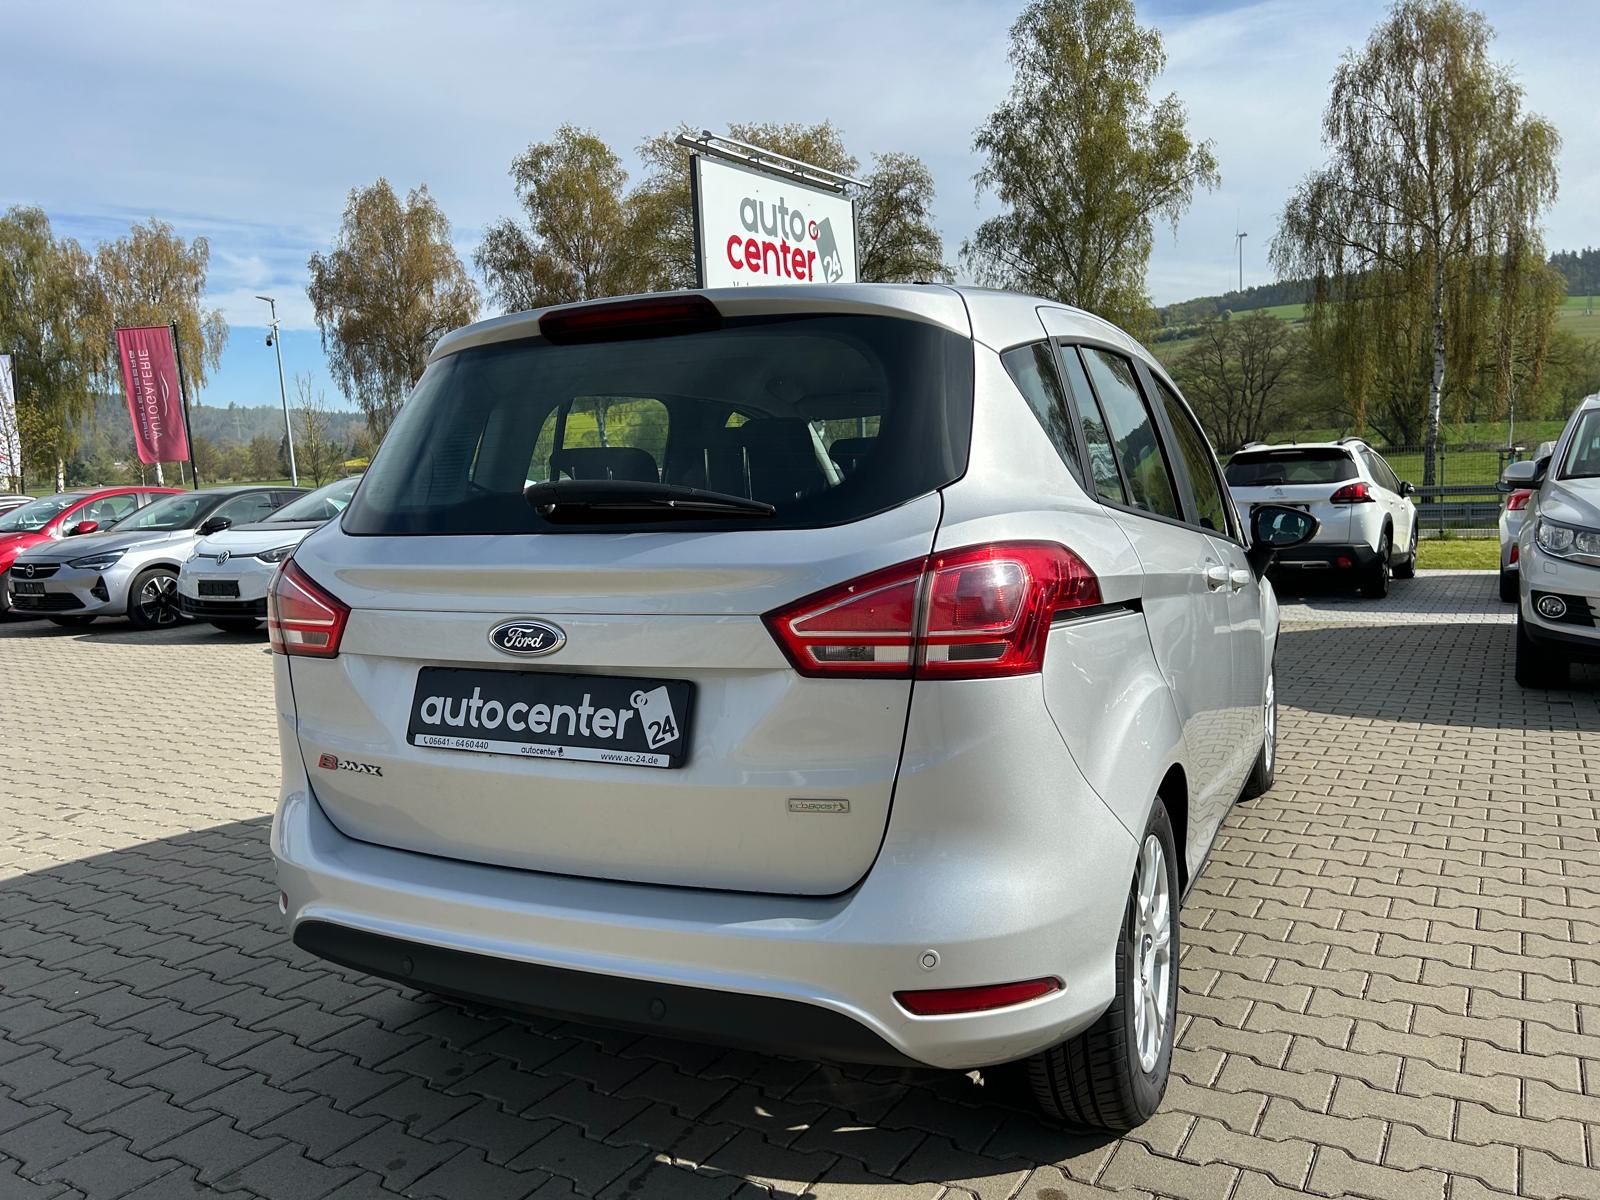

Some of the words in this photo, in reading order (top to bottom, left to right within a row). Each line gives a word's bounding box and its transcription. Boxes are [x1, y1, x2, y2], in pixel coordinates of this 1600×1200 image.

[739, 196, 806, 243] auto
[726, 234, 816, 282] center
[823, 250, 842, 283] 24
[503, 627, 544, 648] Ford
[420, 686, 634, 740] autocenter
[647, 714, 676, 746] 24
[318, 752, 383, 777] B-MAX
[521, 746, 557, 756] autocenter
[600, 752, 659, 765] www.ac-24.de
